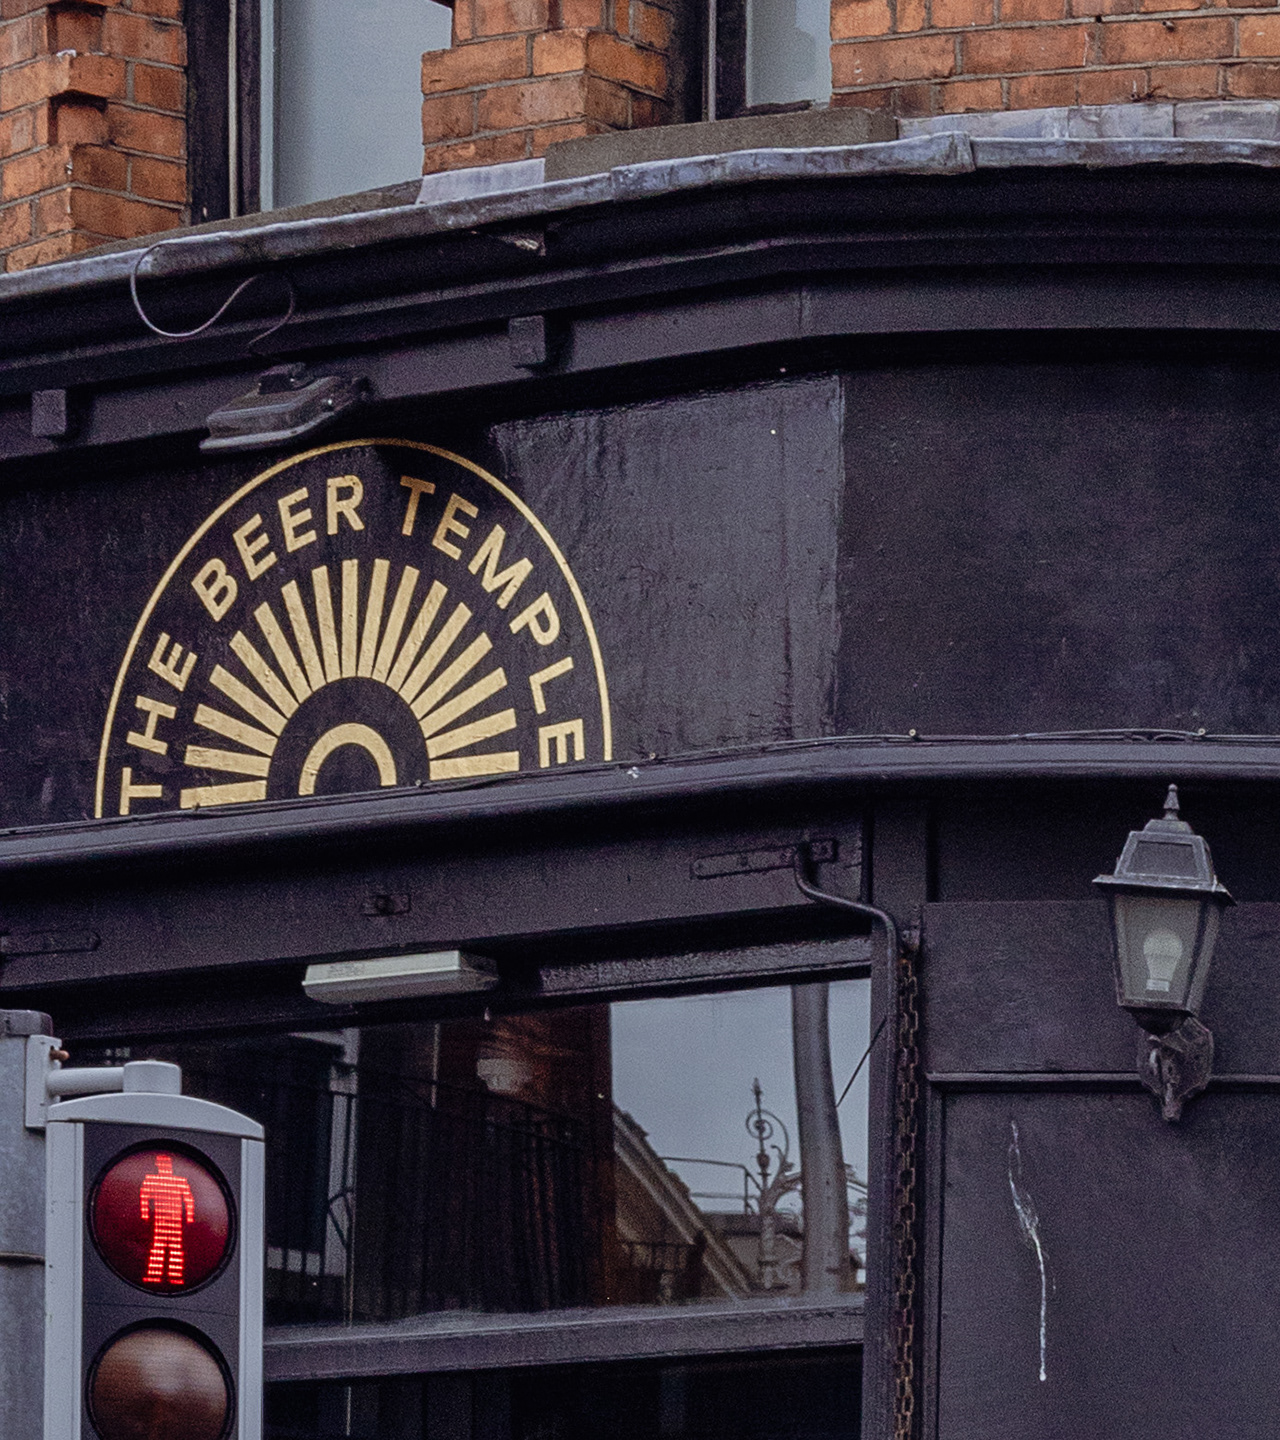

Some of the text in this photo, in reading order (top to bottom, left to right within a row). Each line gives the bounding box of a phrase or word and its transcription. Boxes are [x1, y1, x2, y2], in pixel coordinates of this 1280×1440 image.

[119, 474, 585, 816] THE BEER TEMPLE
